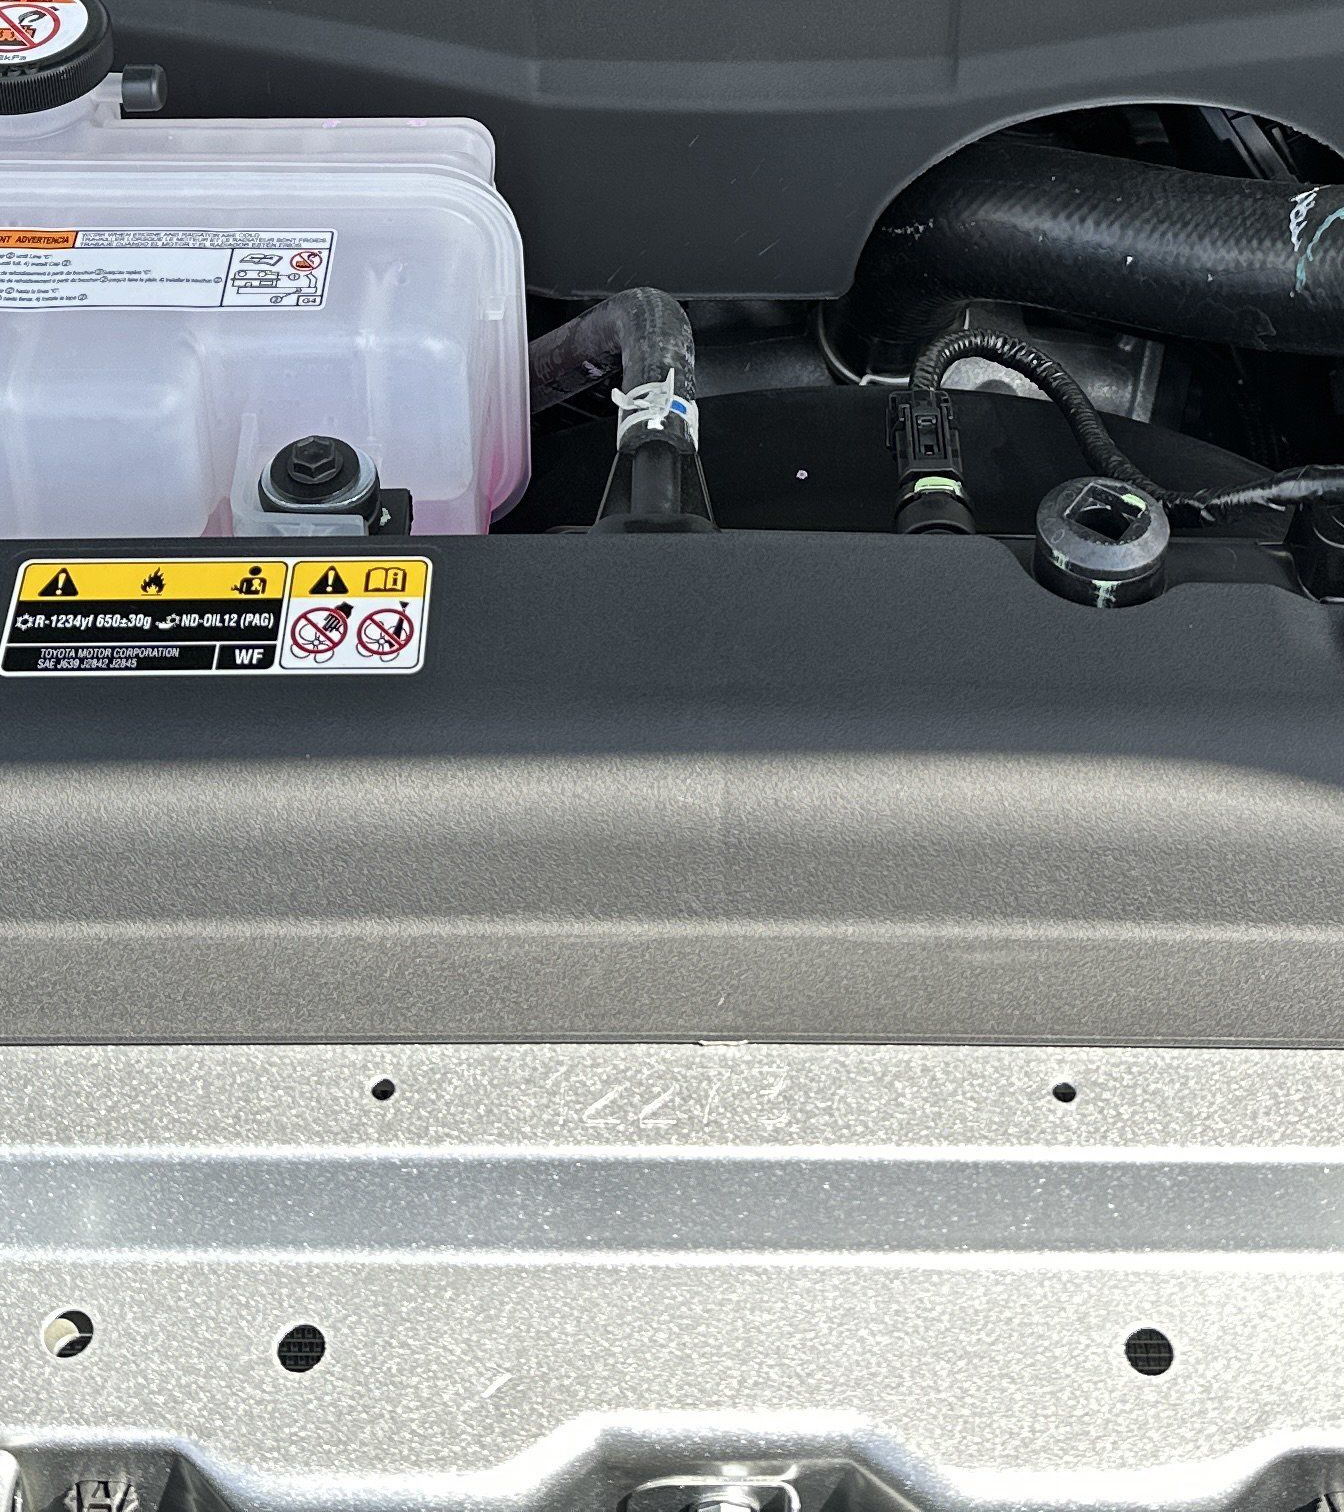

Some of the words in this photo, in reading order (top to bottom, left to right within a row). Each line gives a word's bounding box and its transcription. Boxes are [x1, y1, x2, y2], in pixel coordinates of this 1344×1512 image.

[33, 614, 93, 630] R-1234yf
[95, 614, 152, 630] 650±30g
[180, 614, 238, 629] ND-OIL12
[239, 613, 275, 630] (PAG)
[40, 648, 76, 659] TOYOTA
[77, 648, 112, 658] MOTOR
[113, 647, 180, 658] CORPORATION
[234, 648, 265, 665] WF
[36, 658, 56, 670] SAE
